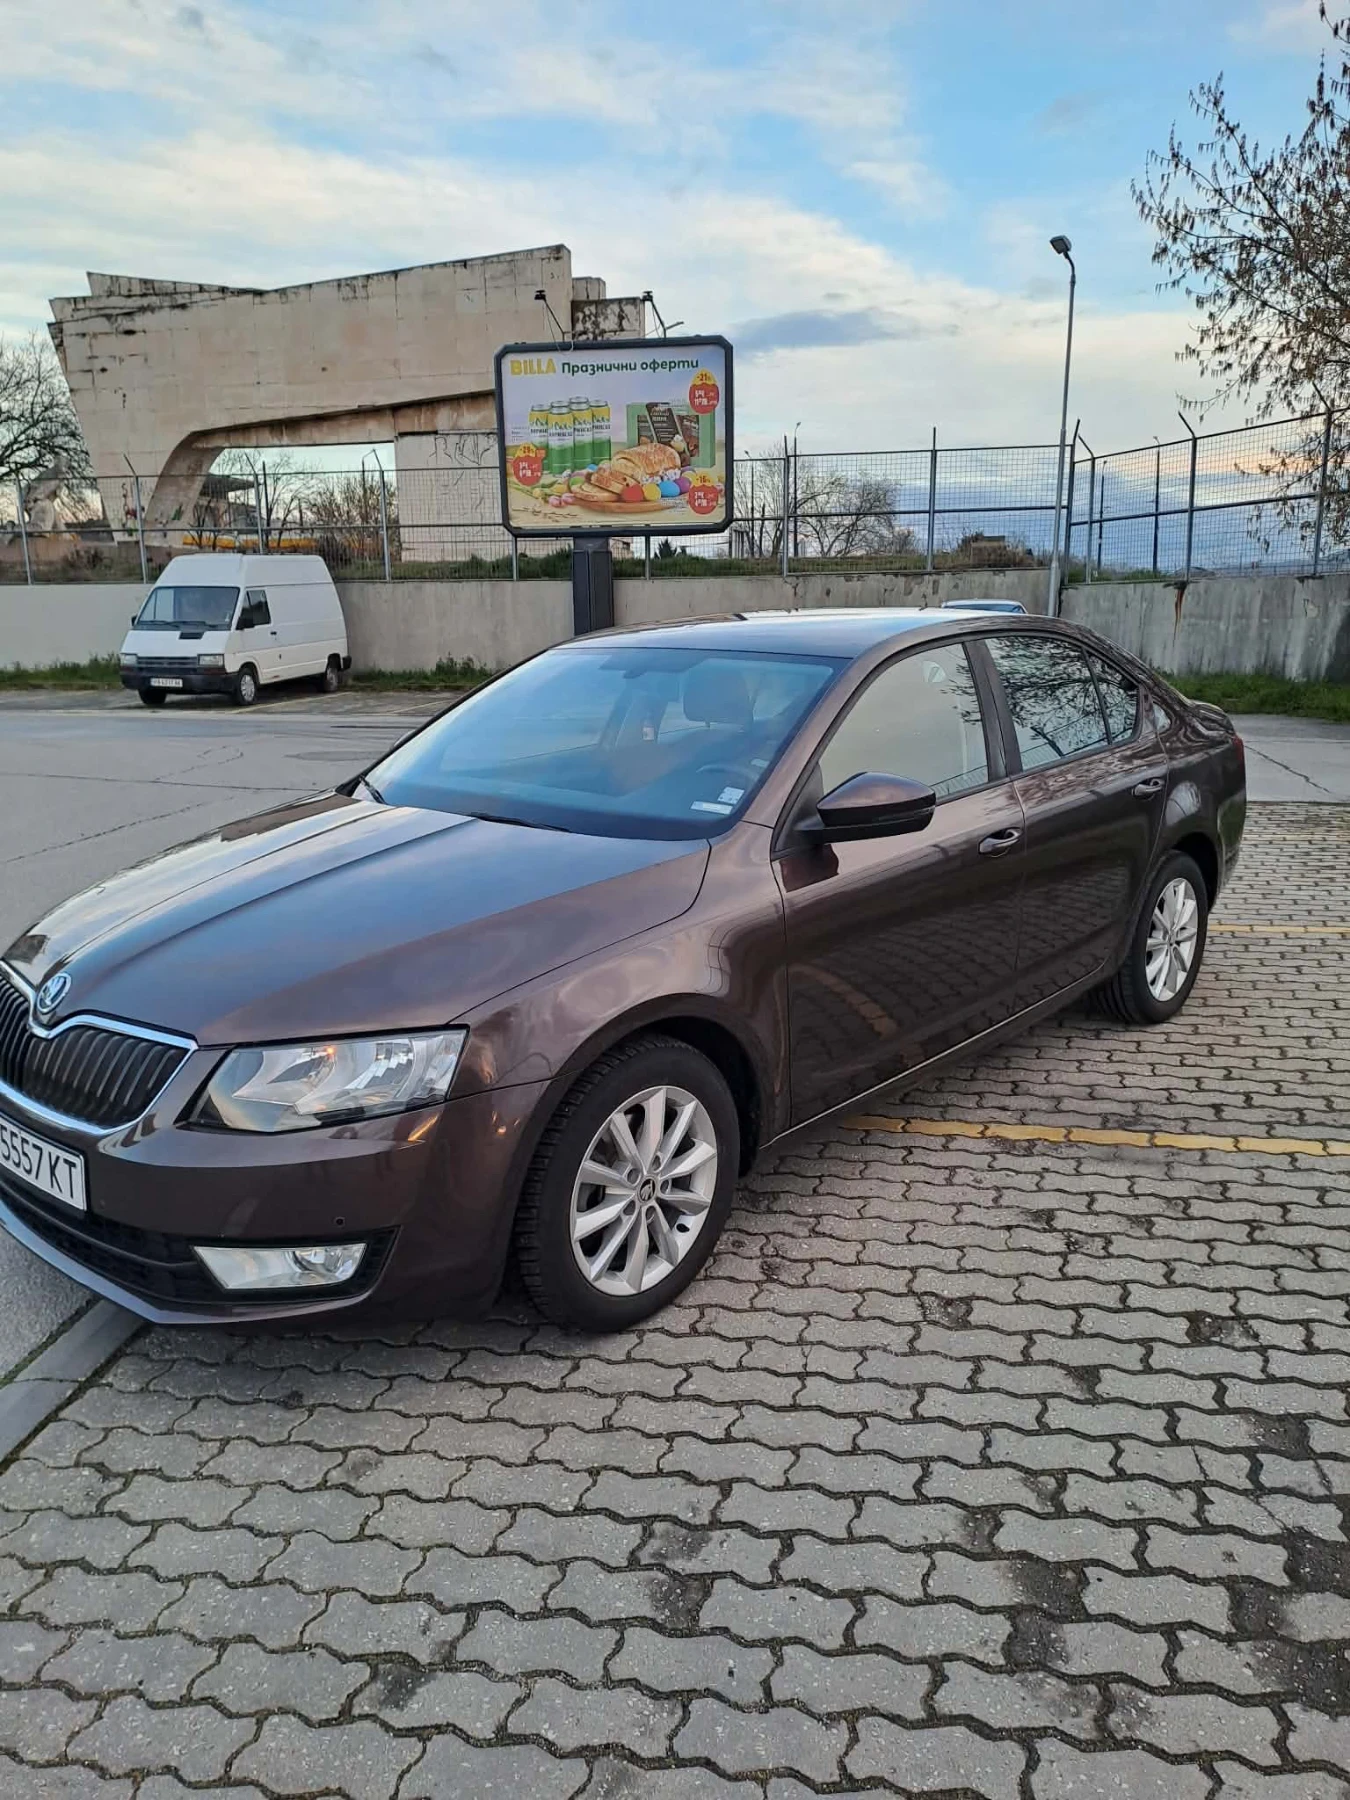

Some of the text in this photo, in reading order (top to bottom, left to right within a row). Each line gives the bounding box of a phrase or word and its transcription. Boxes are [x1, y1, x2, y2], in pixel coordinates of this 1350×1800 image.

[510, 358, 557, 376] BILLA
[561, 357, 699, 377] Празнични оферти
[0, 1124, 77, 1200] 5557 KT
